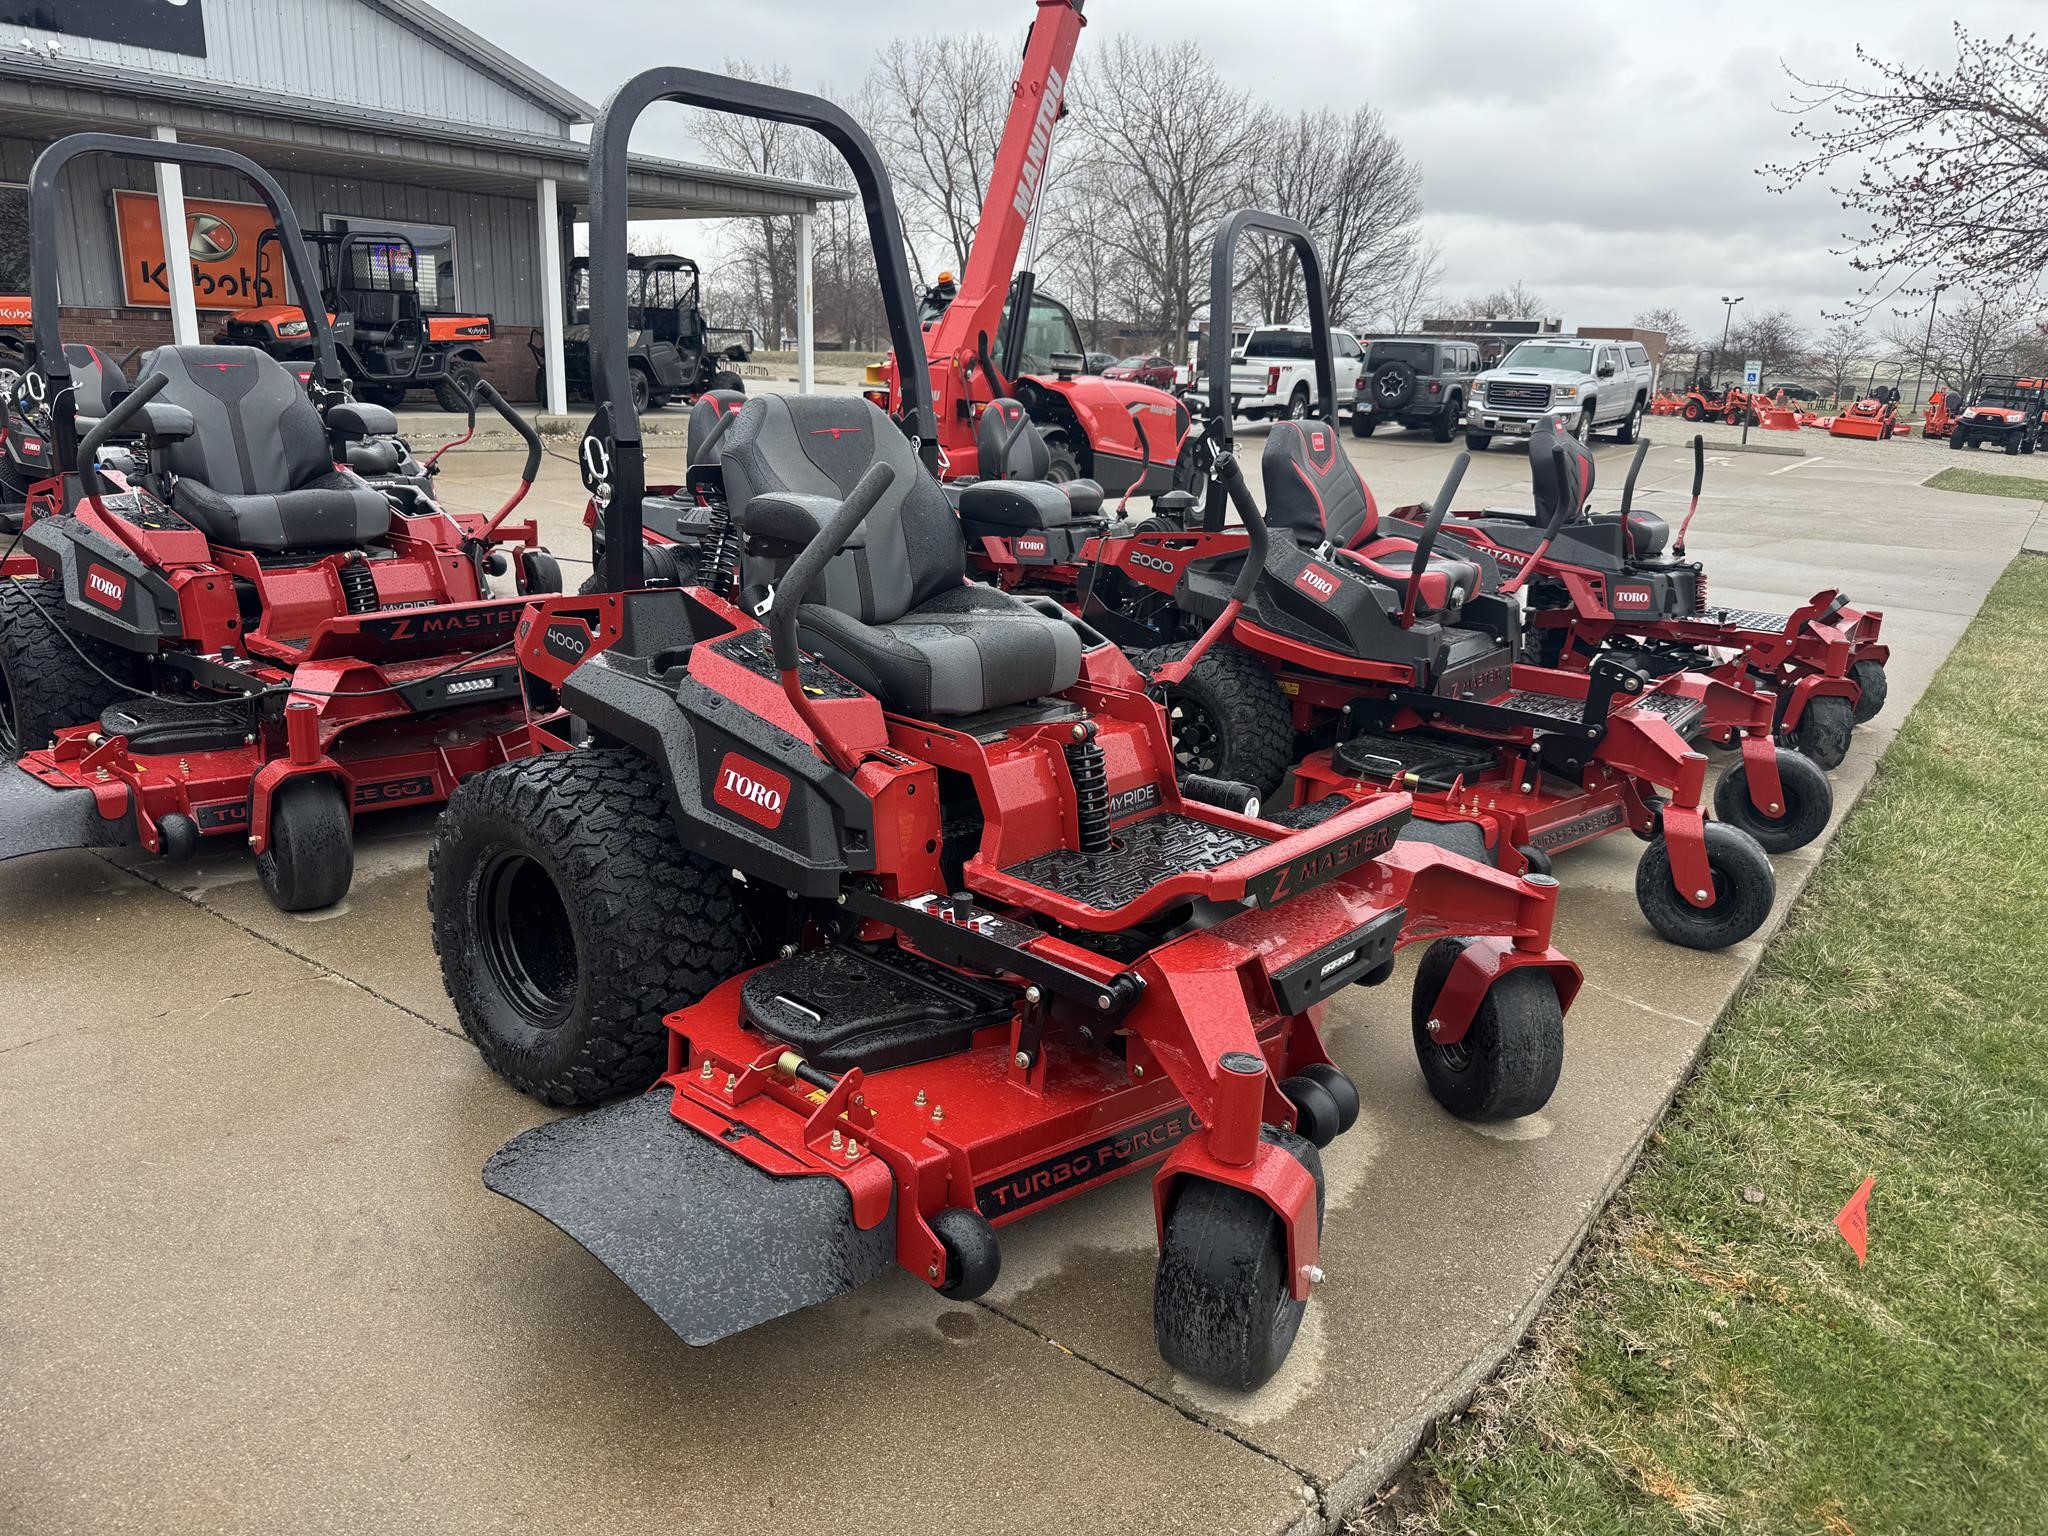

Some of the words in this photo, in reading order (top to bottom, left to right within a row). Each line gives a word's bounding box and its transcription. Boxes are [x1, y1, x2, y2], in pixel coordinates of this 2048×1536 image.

[1013, 66, 1063, 221] MANITOU
[141, 261, 273, 299] Kbota
[0, 308, 32, 319] Kubo
[1504, 389, 1532, 398] GMC
[24, 442, 41, 452] TORO
[1019, 541, 1044, 550] TORO
[1476, 545, 1525, 566] TITAN
[1130, 550, 1174, 573] 2000
[90, 573, 122, 599] TORO
[1301, 569, 1333, 595] TORO
[1616, 591, 1649, 603] TORO
[390, 620, 416, 641] Z
[547, 628, 584, 655] 4000
[1463, 668, 1502, 692] MASTER
[383, 783, 422, 798] 60
[724, 769, 781, 811] TORO
[1270, 866, 1292, 903] Z
[1301, 827, 1390, 882] MASTER
[991, 1154, 1092, 1206] TURBO
[1099, 1117, 1182, 1166] FORCE
